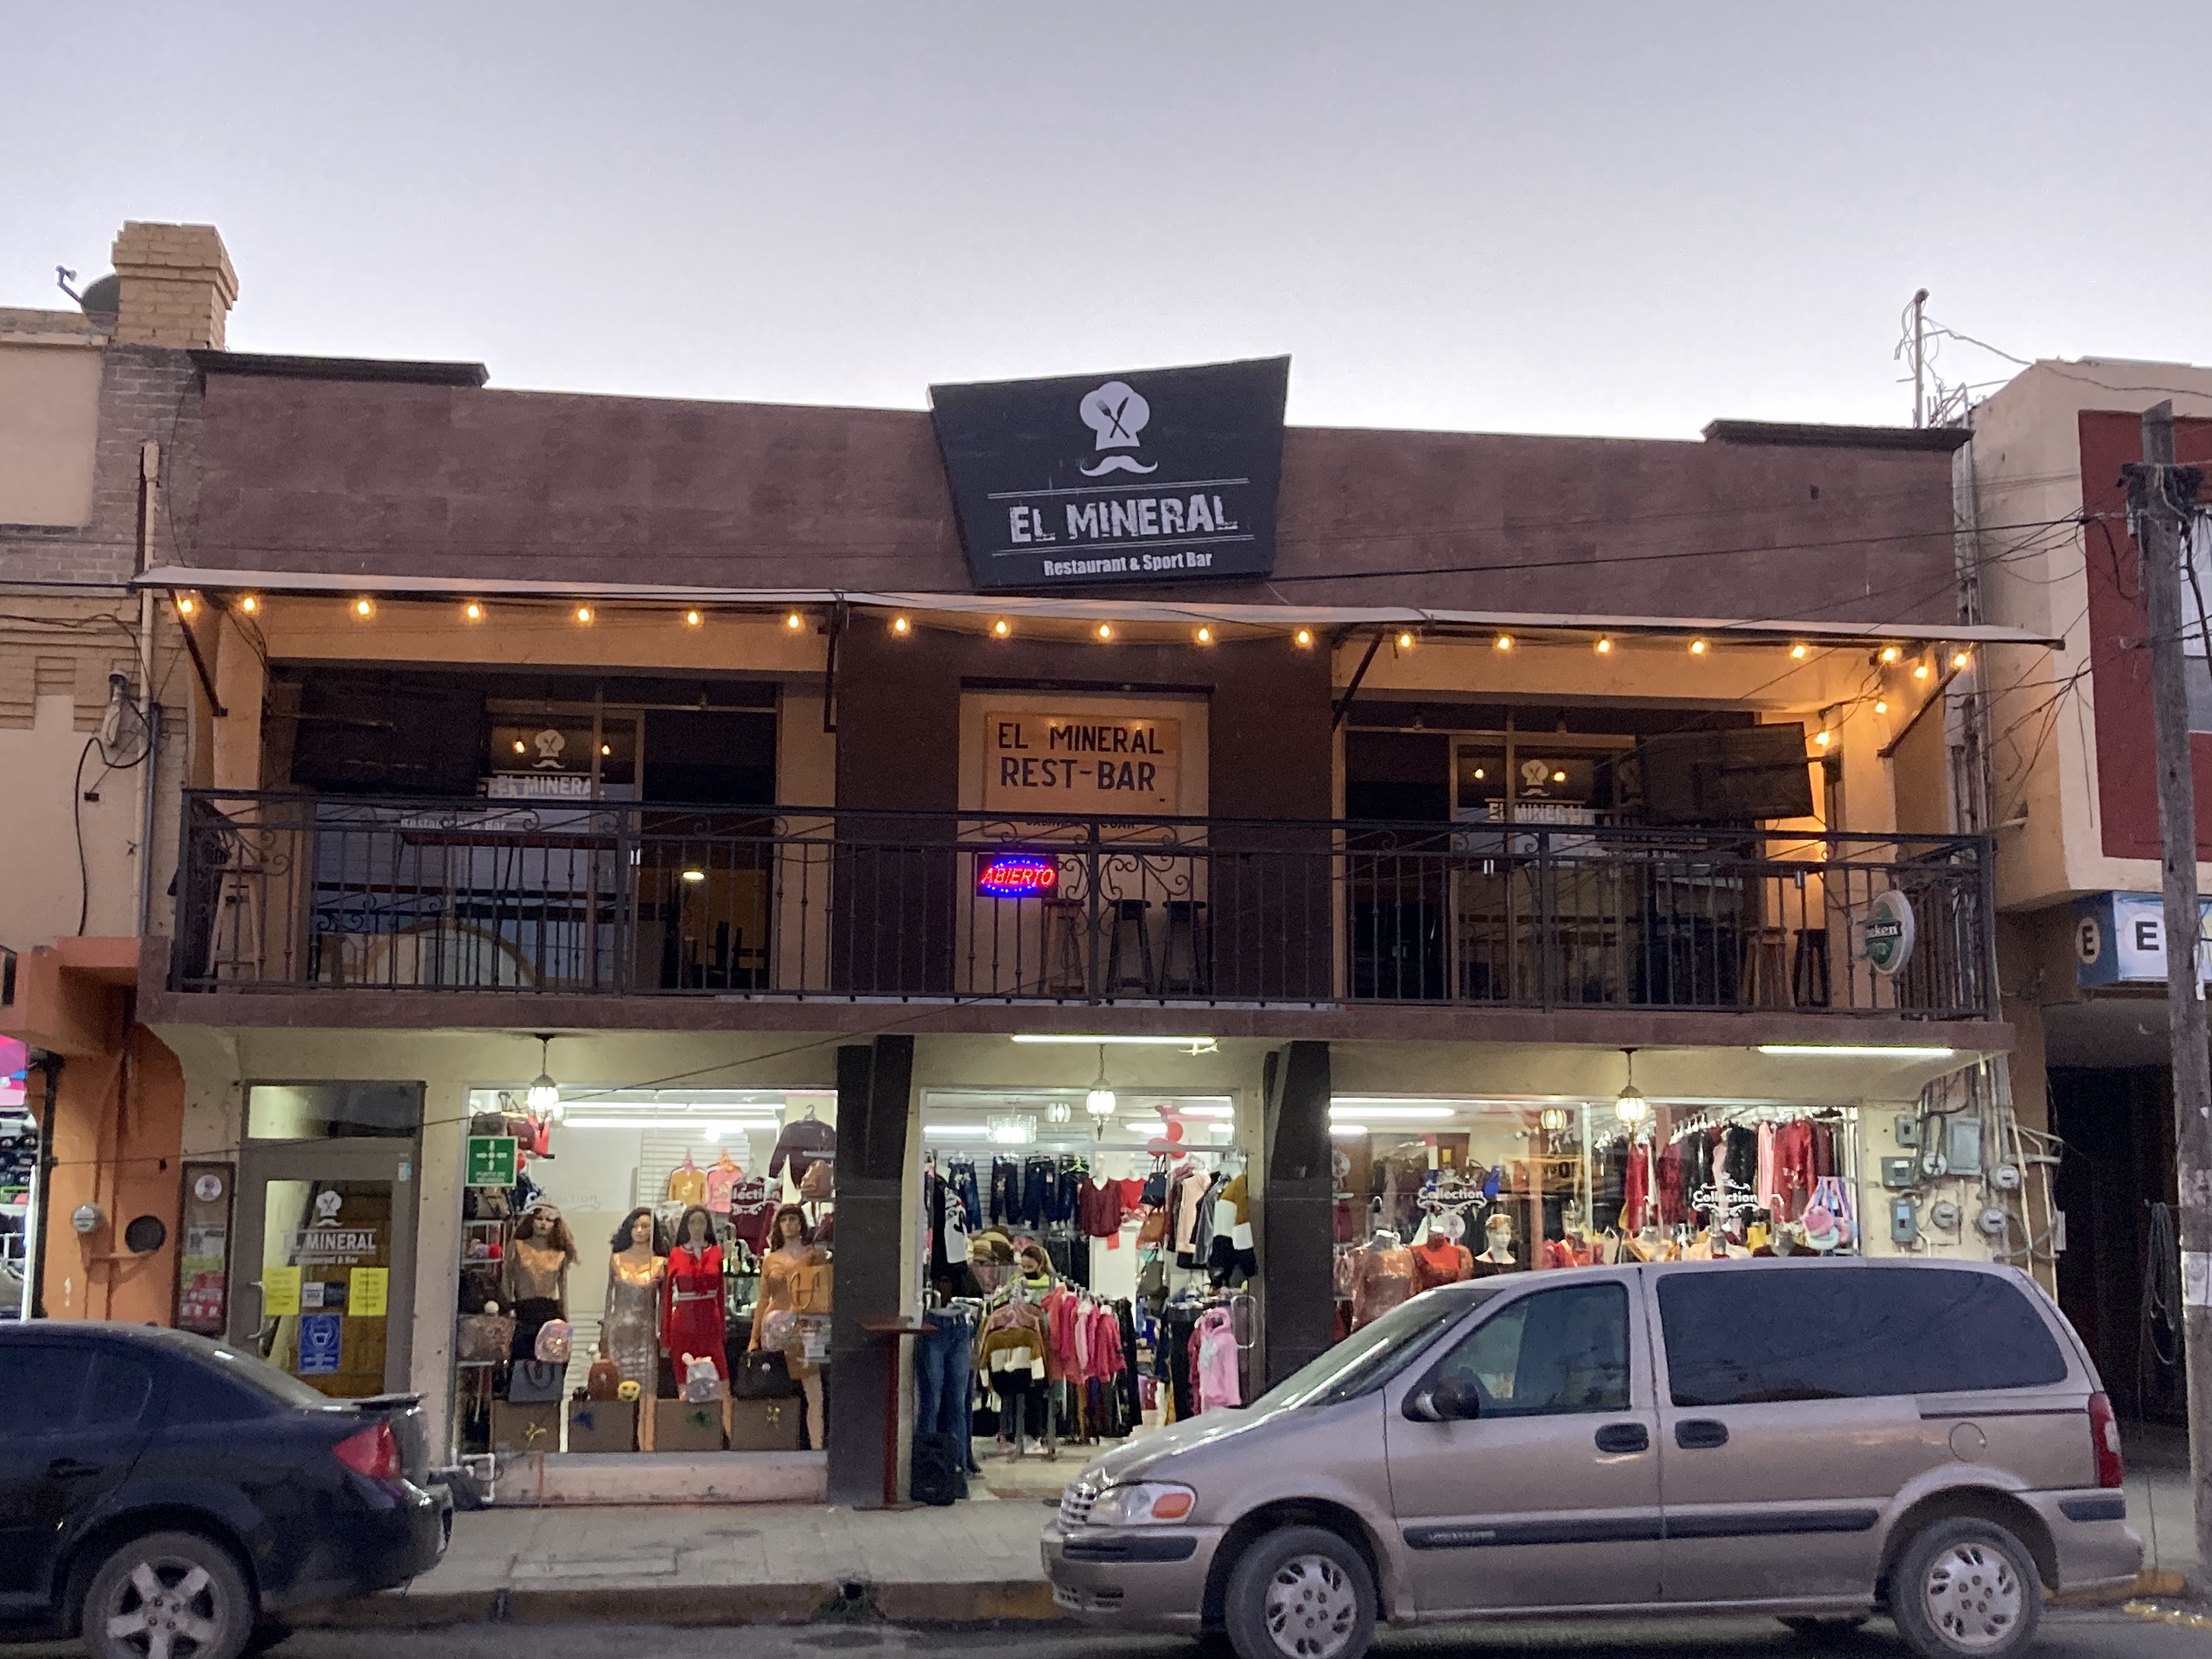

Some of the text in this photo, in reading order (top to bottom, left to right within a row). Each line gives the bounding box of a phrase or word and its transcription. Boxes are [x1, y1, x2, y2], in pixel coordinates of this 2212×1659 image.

[1009, 493, 1238, 543] EL MINERAL
[1043, 552, 1212, 576] Restaurant & Sport Bar
[998, 723, 1164, 754] EL MINERAL
[525, 775, 605, 795] MINERA
[1001, 756, 1156, 792] REST-BAR
[980, 866, 1056, 888] ABIERTO
[2082, 924, 2095, 956] E
[2135, 921, 2159, 951] E
[1418, 1187, 1484, 1199] Collection
[307, 1233, 376, 1250] MINERAL
